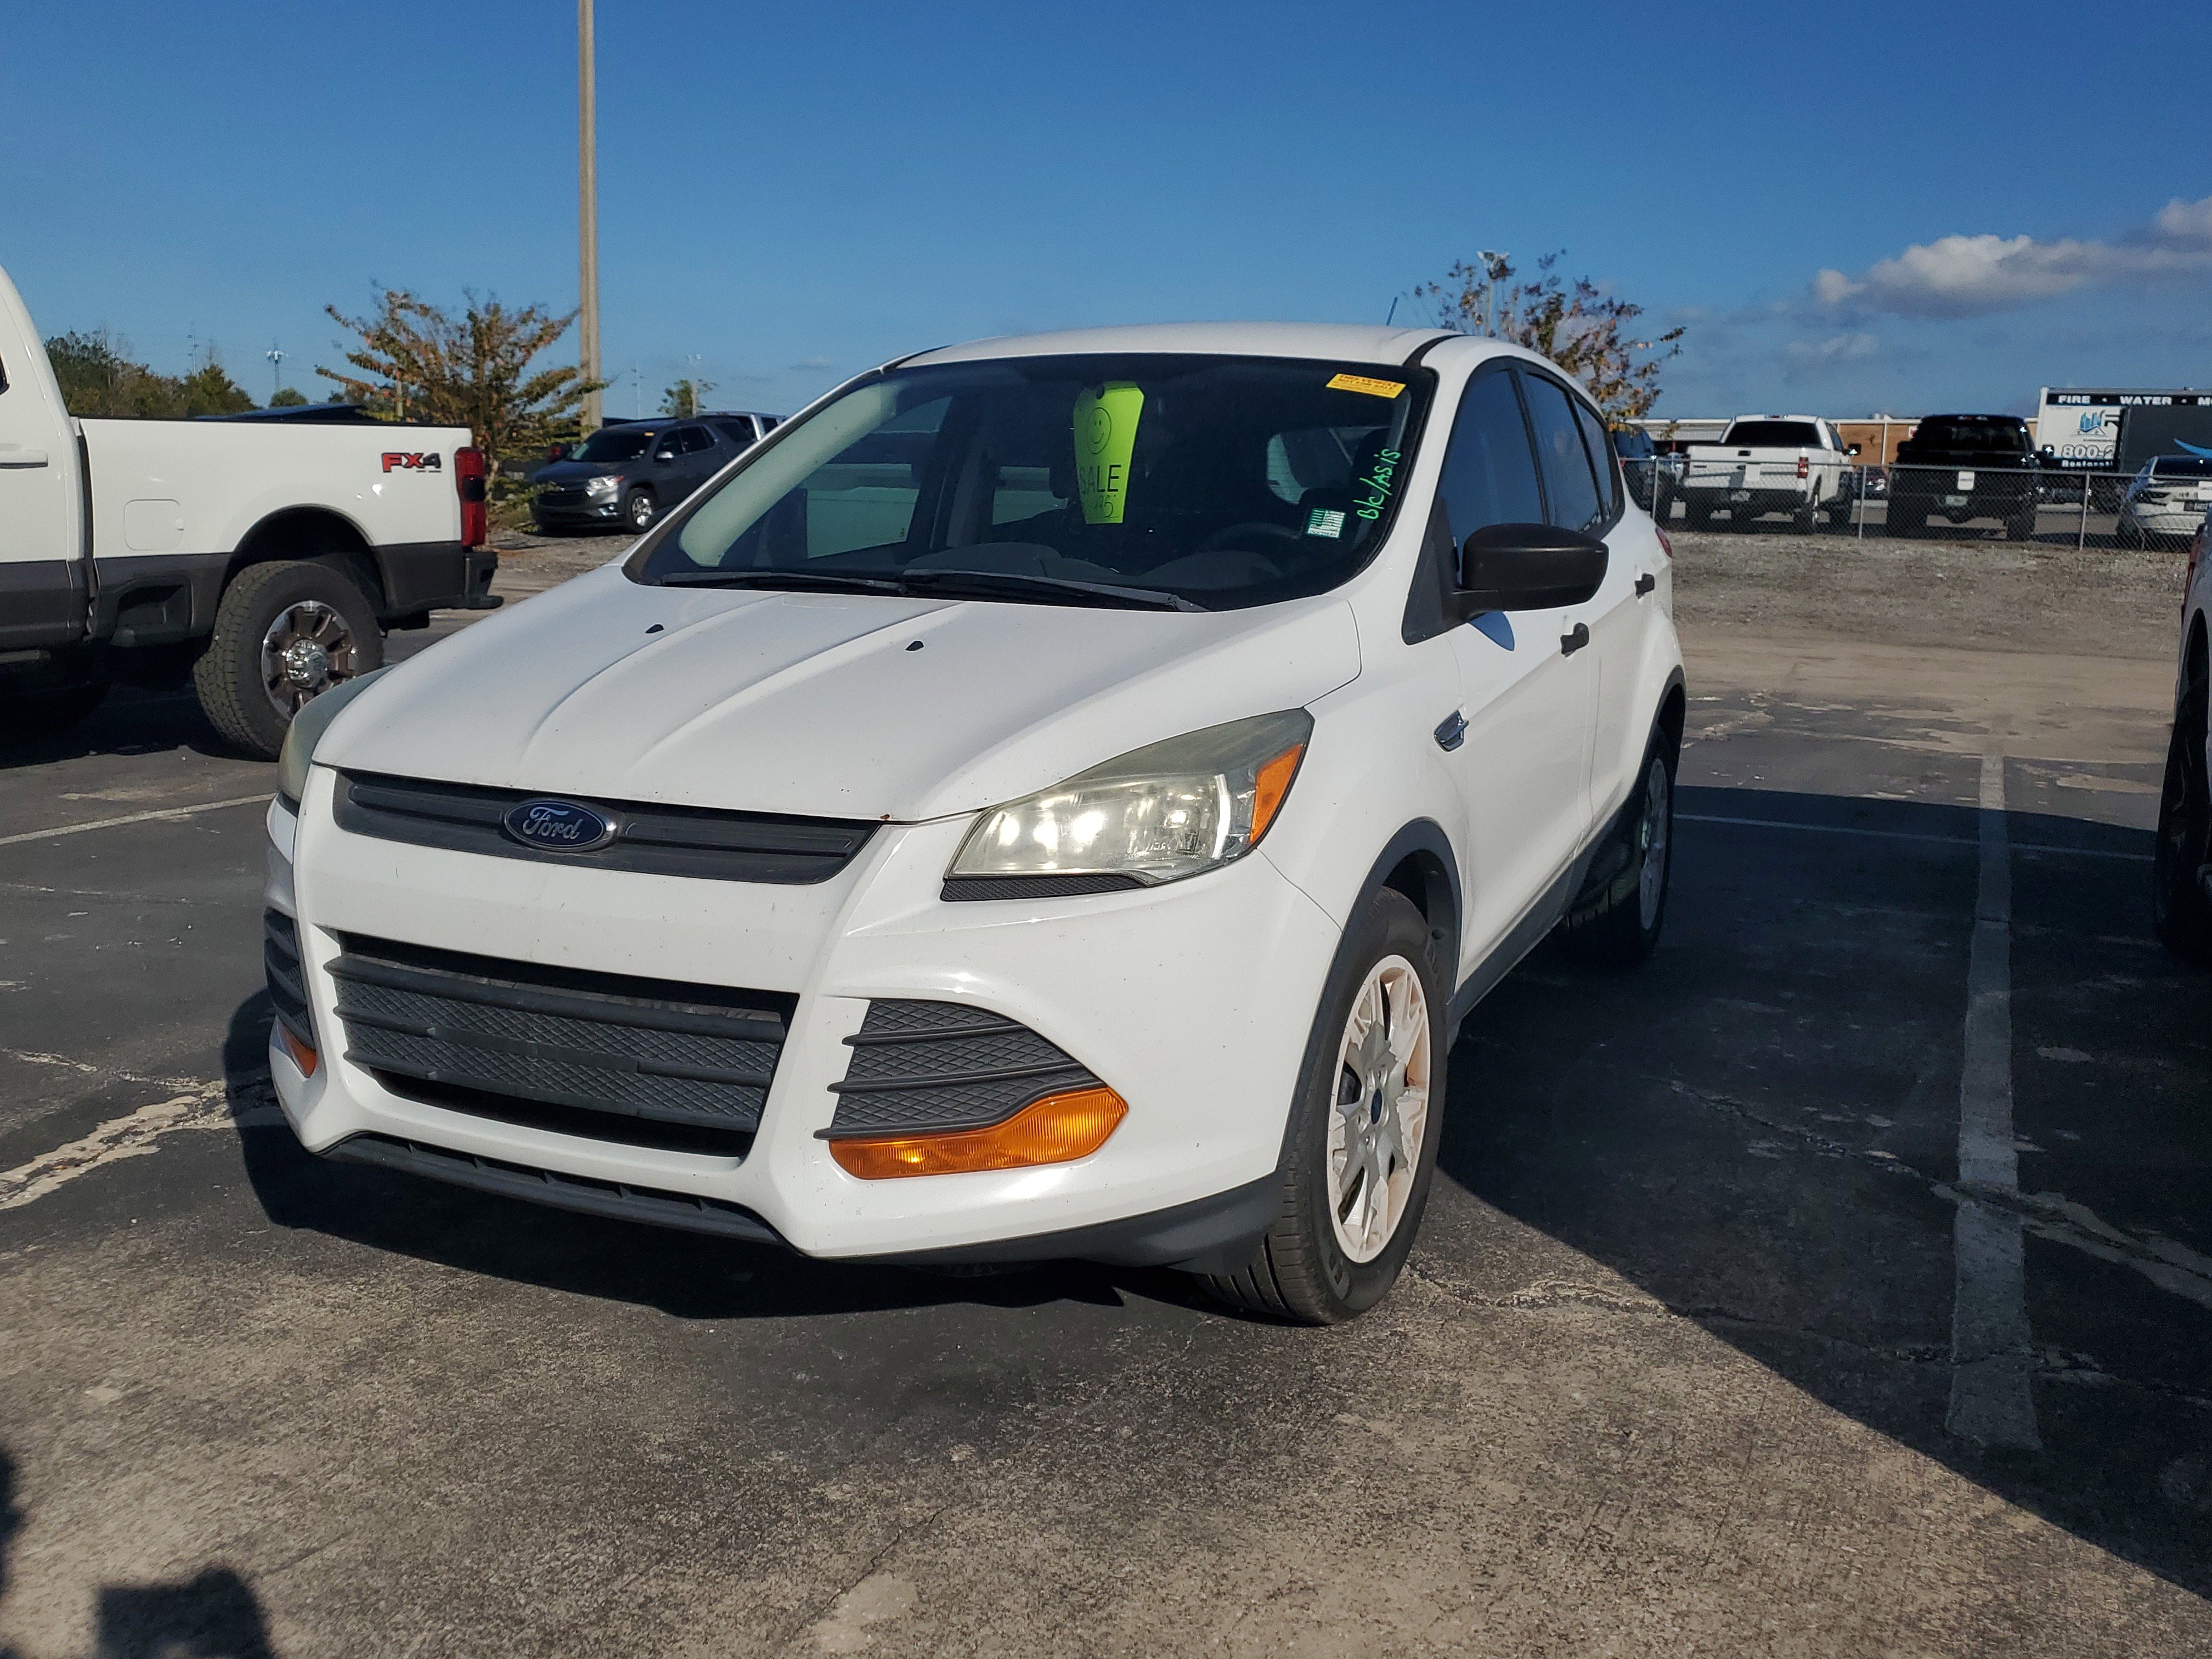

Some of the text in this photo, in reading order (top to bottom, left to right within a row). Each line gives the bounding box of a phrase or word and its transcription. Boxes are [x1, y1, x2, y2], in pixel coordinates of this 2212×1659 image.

[2058, 395, 2212, 406] FIRE WATER M
[381, 453, 442, 473] FX4
[1078, 464, 1121, 493] SALE
[522, 806, 583, 839] Ford
